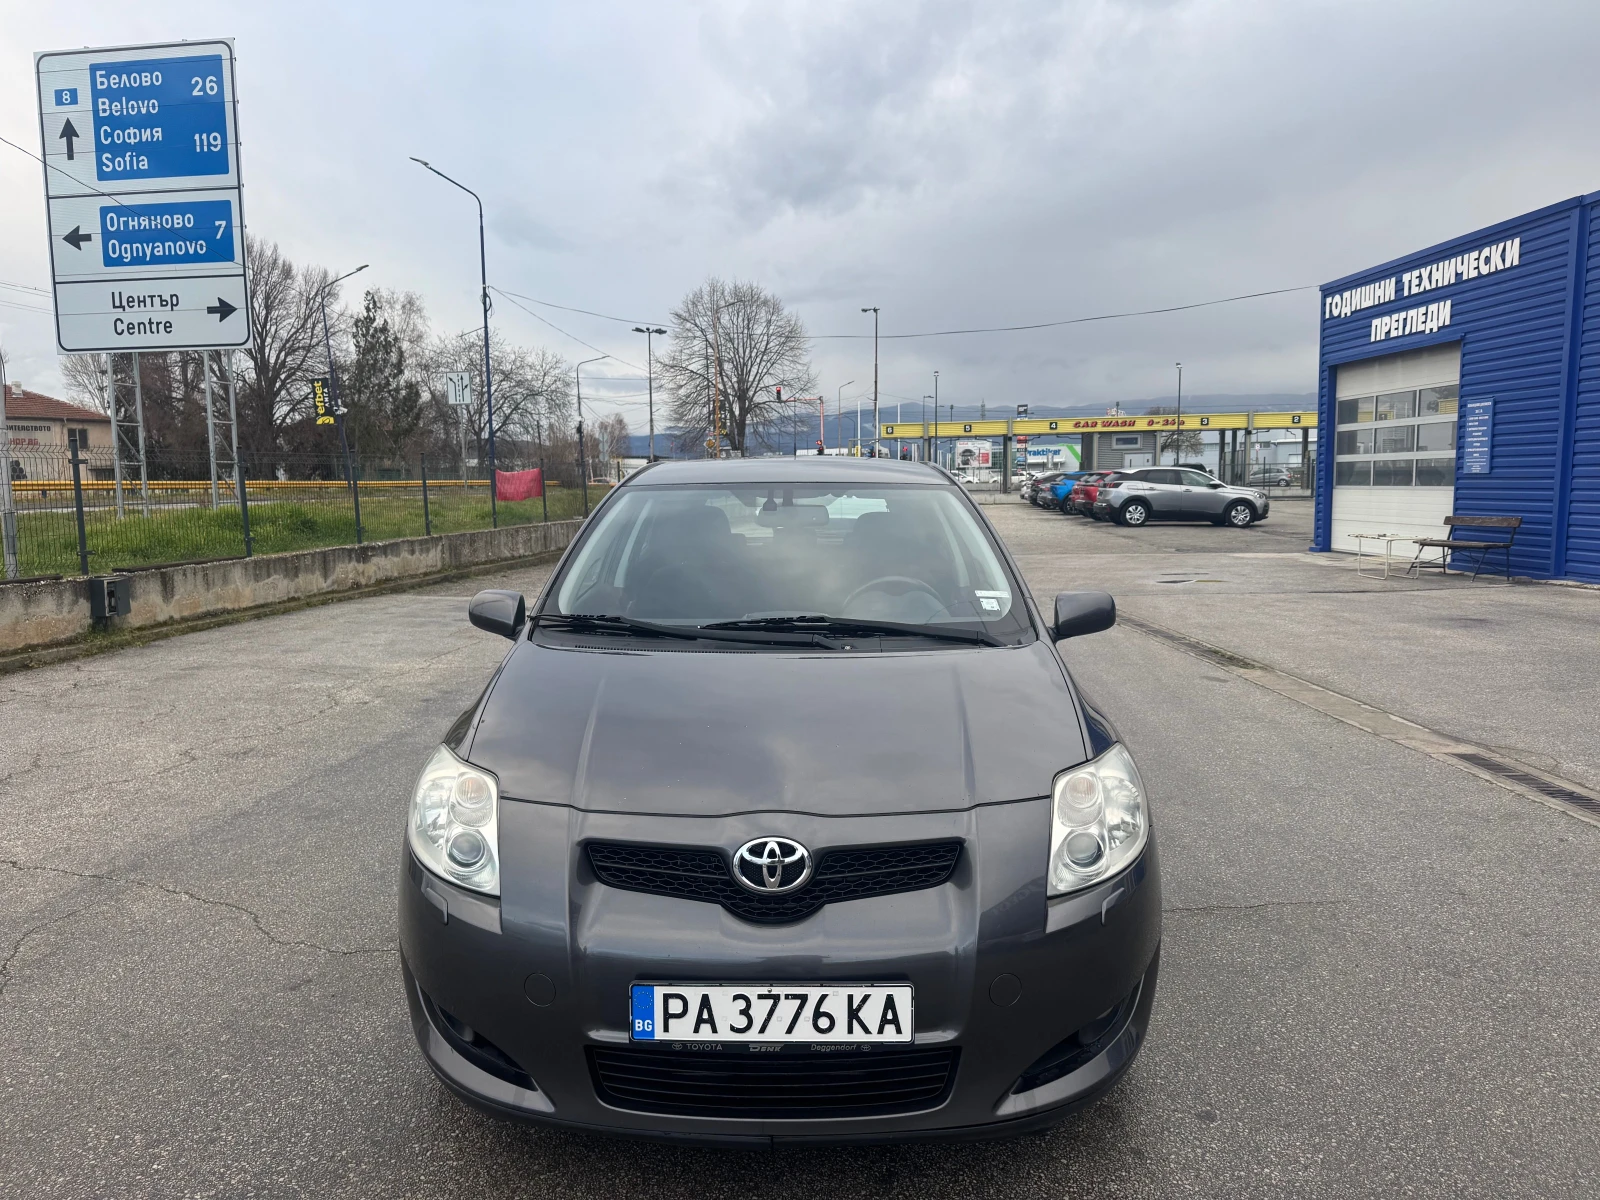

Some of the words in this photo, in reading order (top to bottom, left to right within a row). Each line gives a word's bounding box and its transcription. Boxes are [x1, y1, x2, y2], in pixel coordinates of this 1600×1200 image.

[95, 71, 162, 90] Белово
[191, 75, 218, 96] 26
[62, 90, 71, 104] 8
[97, 96, 159, 117] Belovo
[100, 125, 163, 145] София
[194, 132, 222, 152] 119
[101, 152, 149, 172] Sofia
[106, 212, 195, 232] Огняново
[214, 220, 227, 240] 7
[108, 239, 207, 263] Ognyanovo
[1325, 277, 1396, 320] ГОДИШНИ
[1402, 237, 1521, 297] ТЕХНИЧЕСКИ
[111, 291, 180, 312] Център
[113, 317, 173, 336] Centre
[1370, 299, 1452, 343] ПРЕГЛЕДИ
[313, 380, 326, 415] efbet
[1073, 420, 1098, 428] CAR
[1101, 419, 1136, 427] WASH
[635, 1019, 653, 1031] BG
[686, 1043, 723, 1051] TOYOTA
[811, 1043, 857, 1051] Deggendorf
